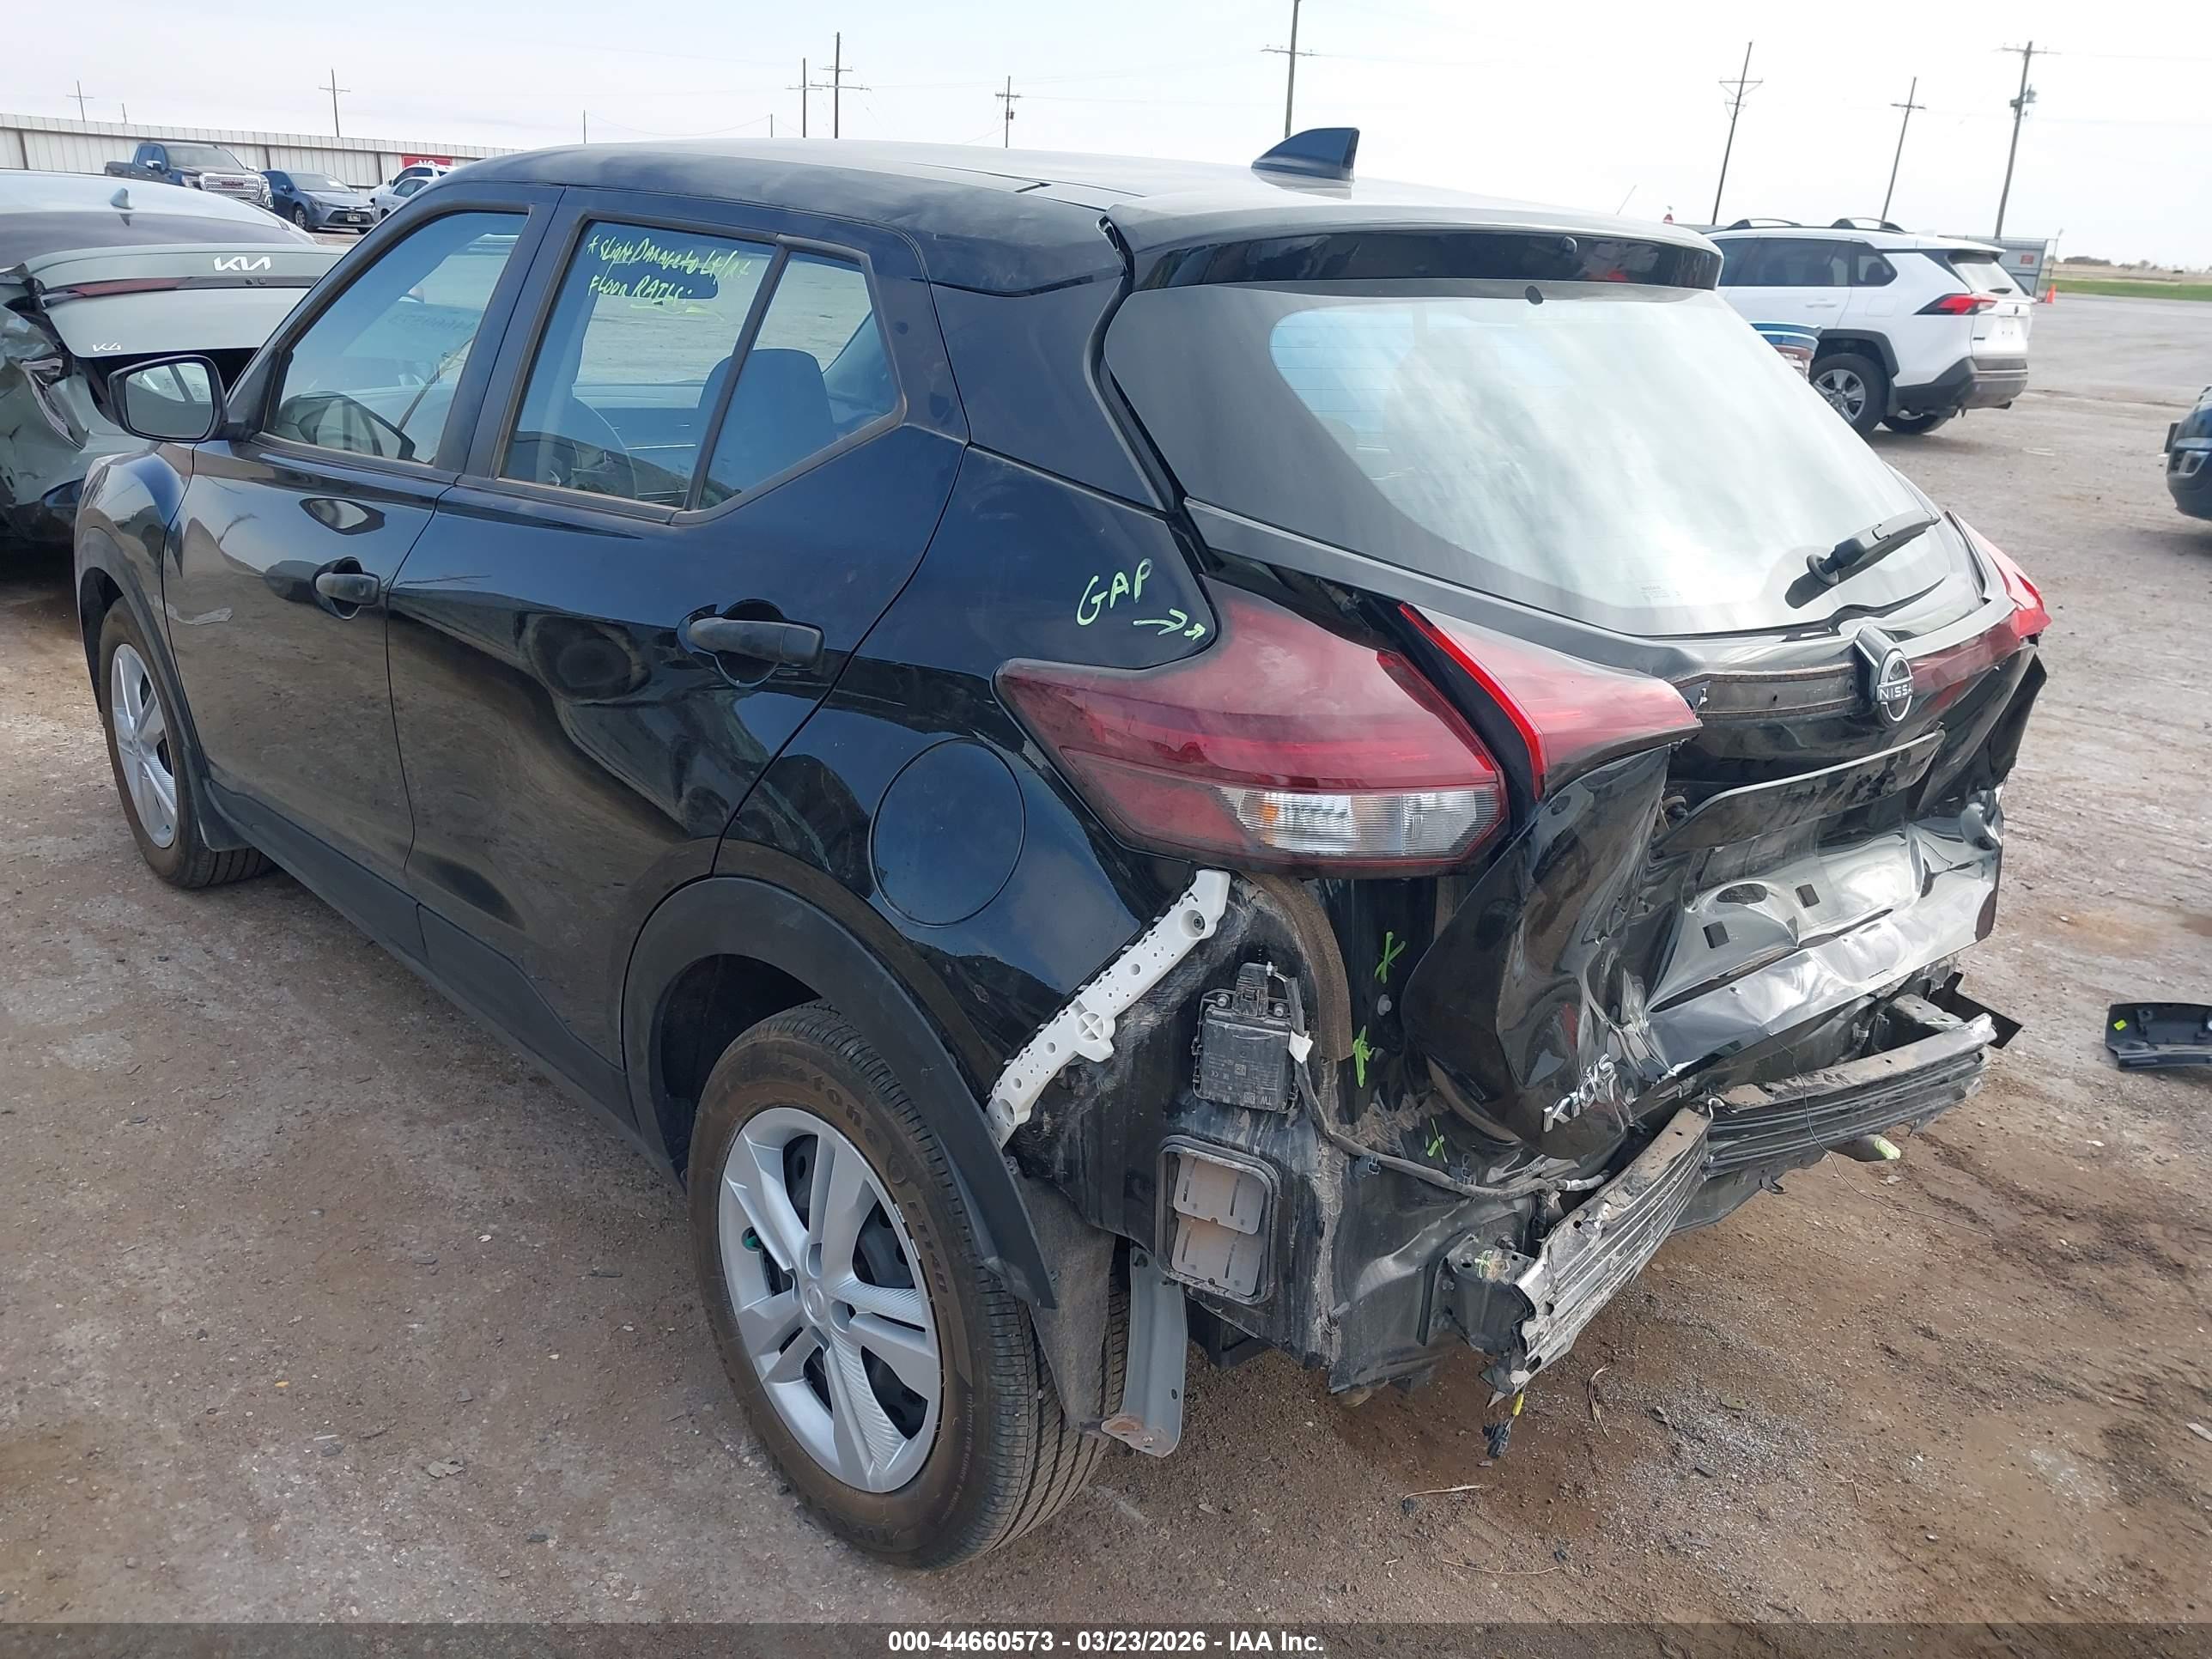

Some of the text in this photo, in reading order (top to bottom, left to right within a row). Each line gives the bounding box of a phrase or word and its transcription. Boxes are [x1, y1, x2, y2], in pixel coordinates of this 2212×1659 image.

[214, 257, 270, 270] KIA
[93, 343, 121, 352] K4
[1077, 558, 1152, 626] GAP
